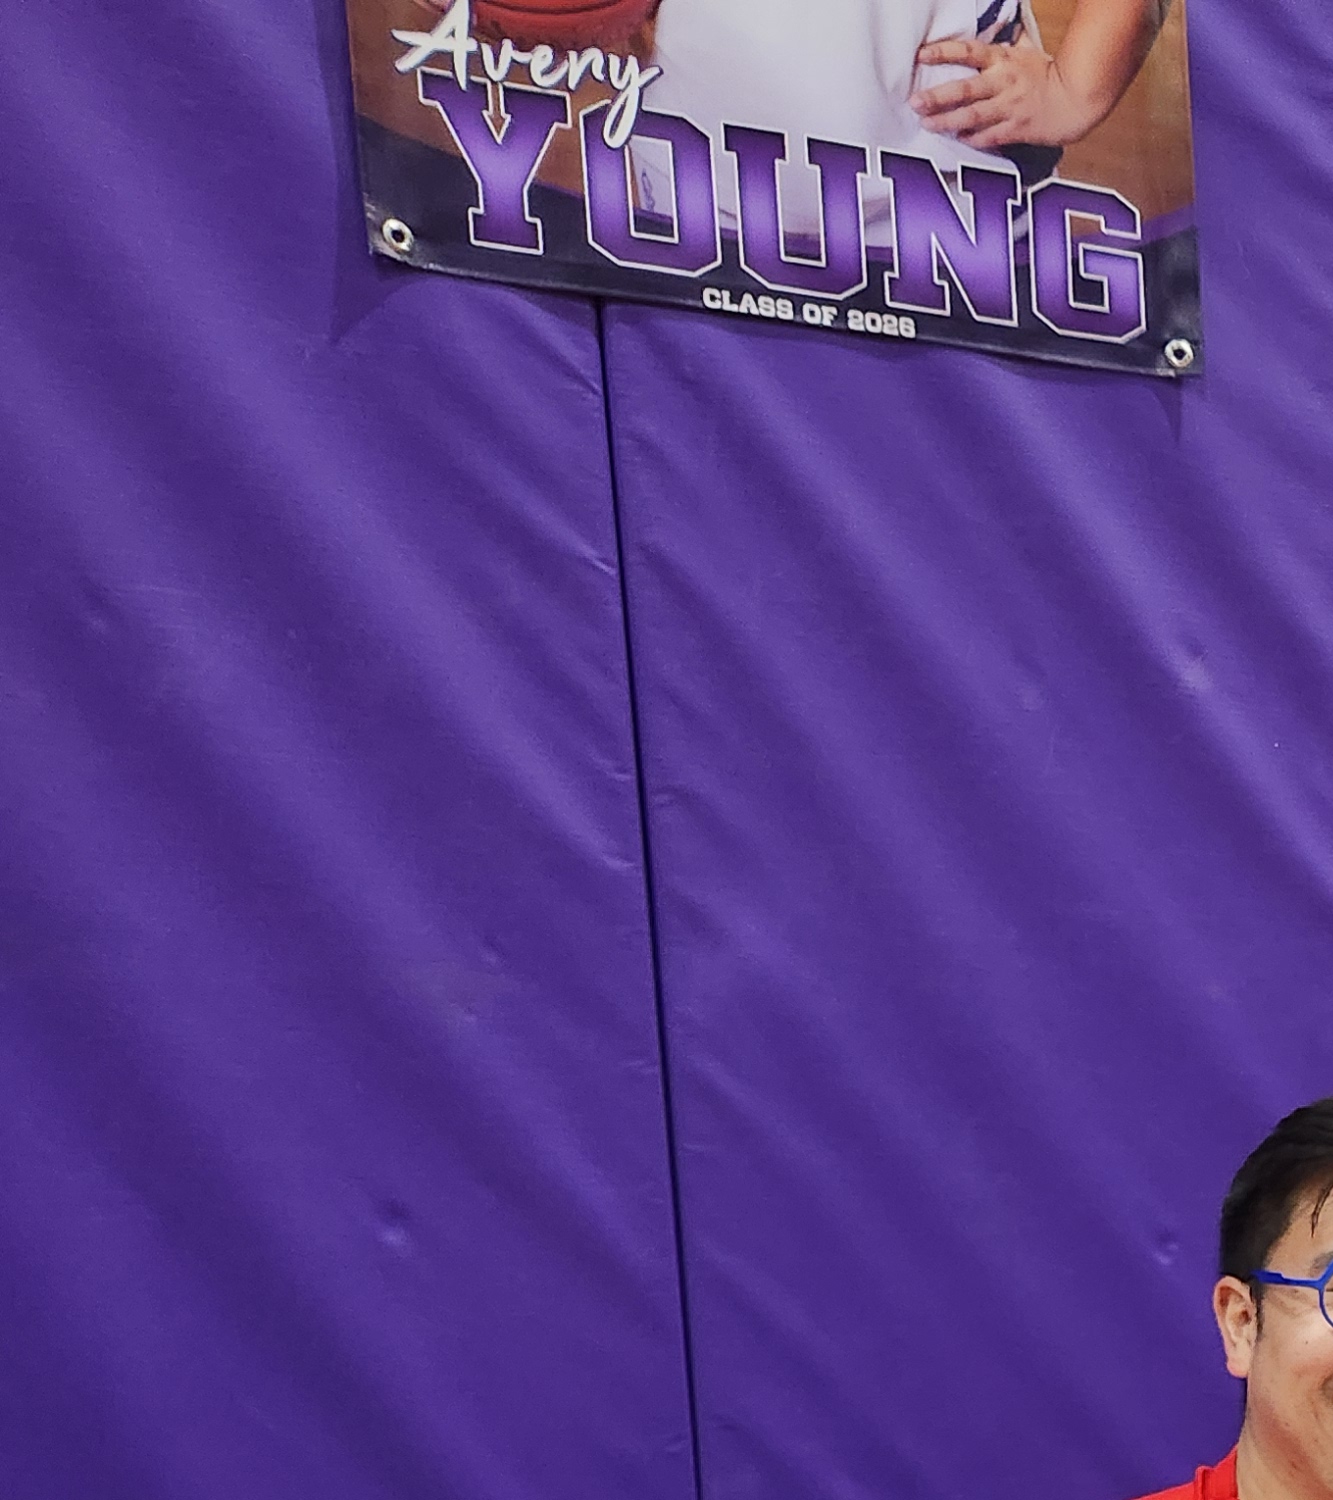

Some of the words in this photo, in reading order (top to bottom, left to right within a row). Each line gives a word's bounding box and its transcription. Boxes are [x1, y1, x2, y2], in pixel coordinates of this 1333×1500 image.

[391, 0, 664, 149] Avery
[417, 67, 1147, 345] YOUNG
[702, 287, 795, 320] CLASS
[802, 302, 839, 327] OF
[847, 309, 916, 339] 2026
